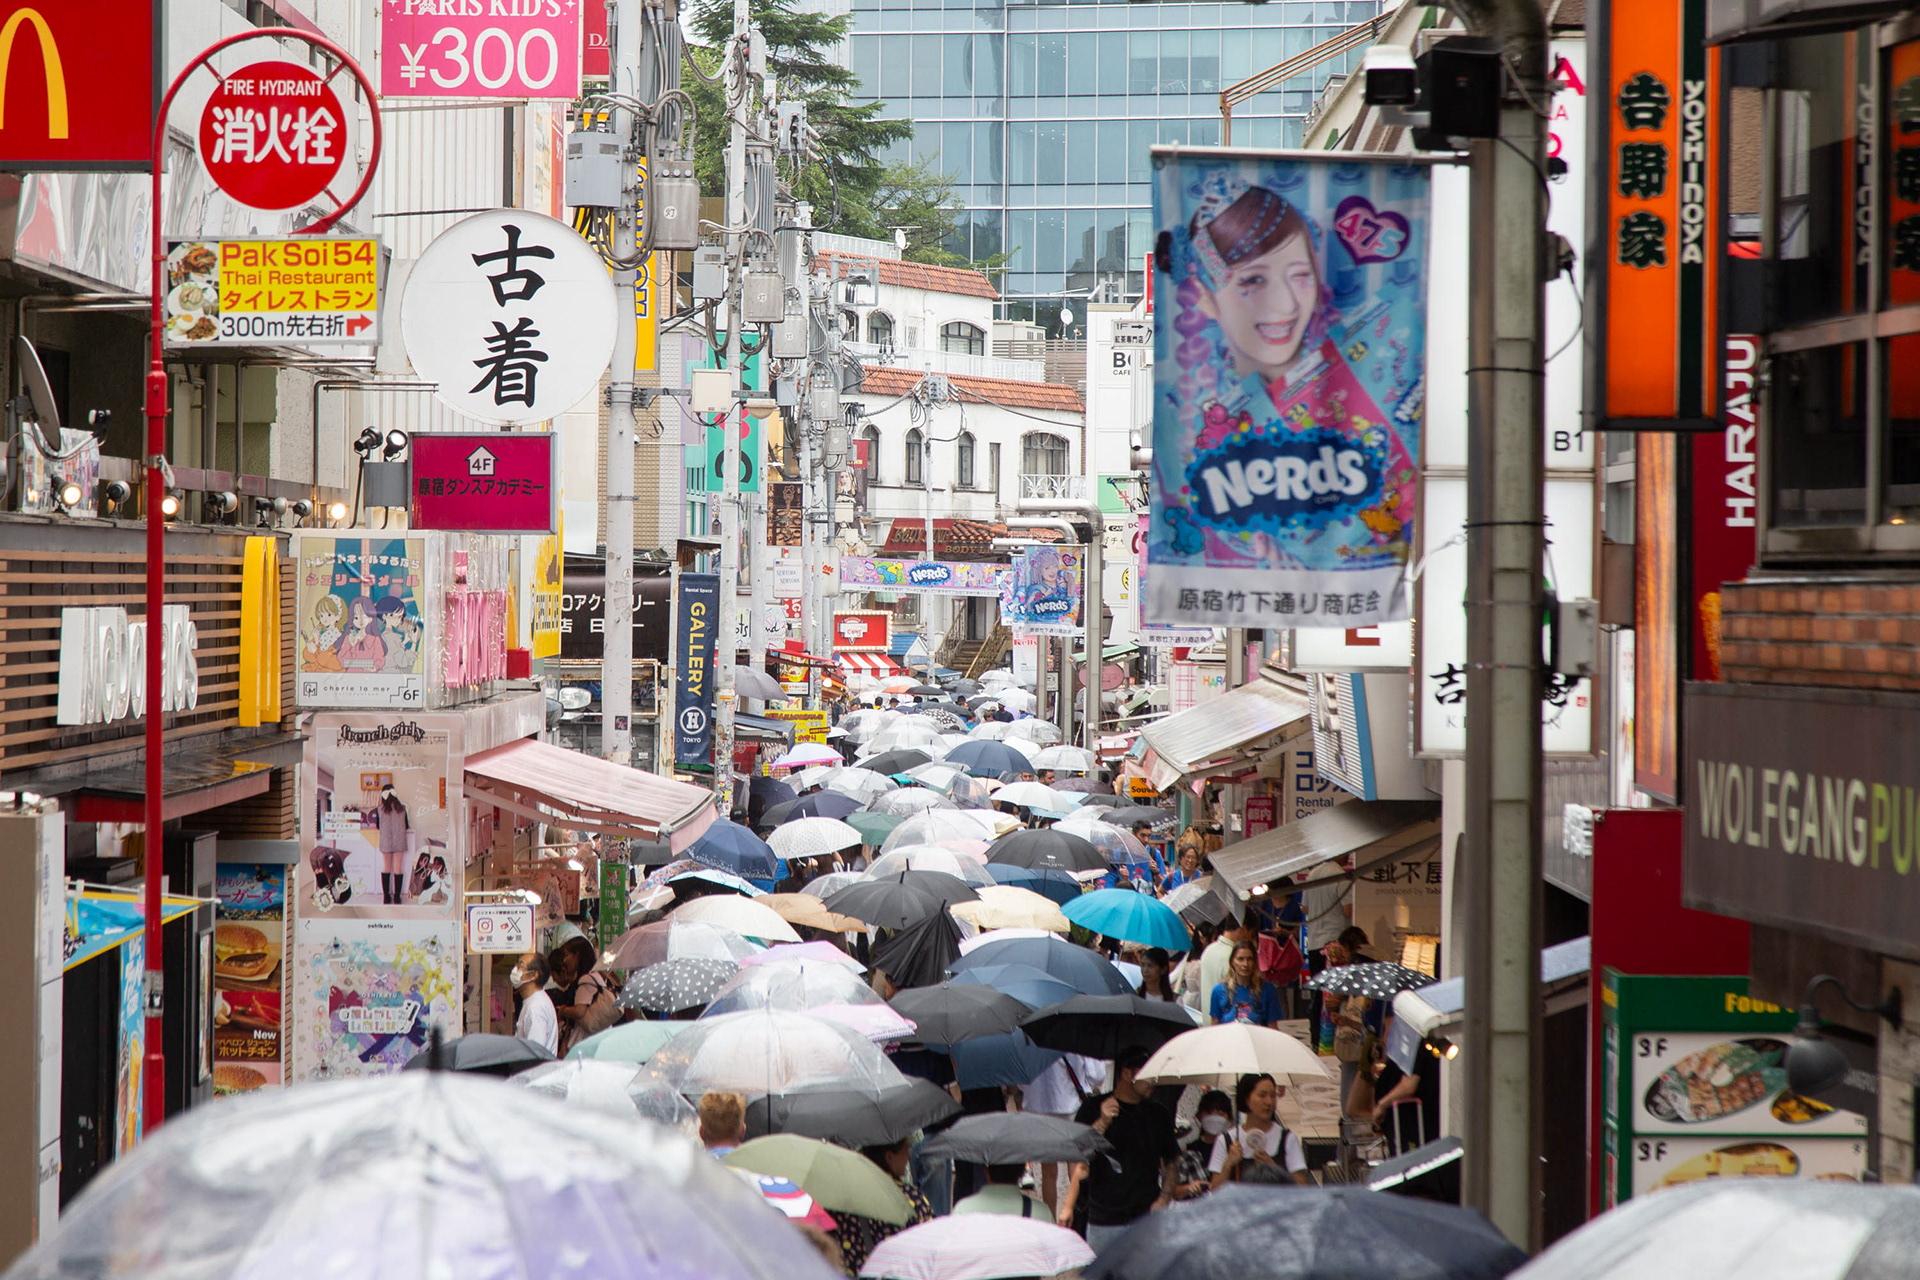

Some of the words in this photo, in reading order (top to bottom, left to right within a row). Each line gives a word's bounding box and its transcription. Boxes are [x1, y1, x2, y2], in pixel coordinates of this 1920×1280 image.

[399, 27, 558, 89] ¥300
[224, 79, 254, 95] FIRE
[259, 80, 323, 96] HYDRANT
[212, 106, 338, 164] 消火栓
[1616, 70, 1672, 269] 吉野家
[222, 243, 278, 267] Pak
[283, 243, 328, 267] Soi
[333, 242, 374, 266] 54
[222, 271, 262, 285] Thai
[269, 270, 374, 285] Restaurant
[223, 290, 374, 310] タイレストラン
[222, 314, 345, 337] 300m先右折
[470, 224, 556, 409] 古着
[1554, 430, 1584, 452] B1
[472, 458, 491, 471] 4F
[418, 477, 545, 496] 原宿ダンスアカデミー
[1177, 588, 1382, 616] 原宿竹下通り商店会
[688, 602, 706, 697] GALLERY
[403, 690, 420, 701] 6F
[390, 721, 426, 742] girly
[1296, 796, 1334, 808] Rental
[1697, 758, 1868, 867] WOLFGANG
[1870, 782, 1920, 876] PU
[253, 1029, 277, 1039] New
[219, 1046, 277, 1058] ホットチキン
